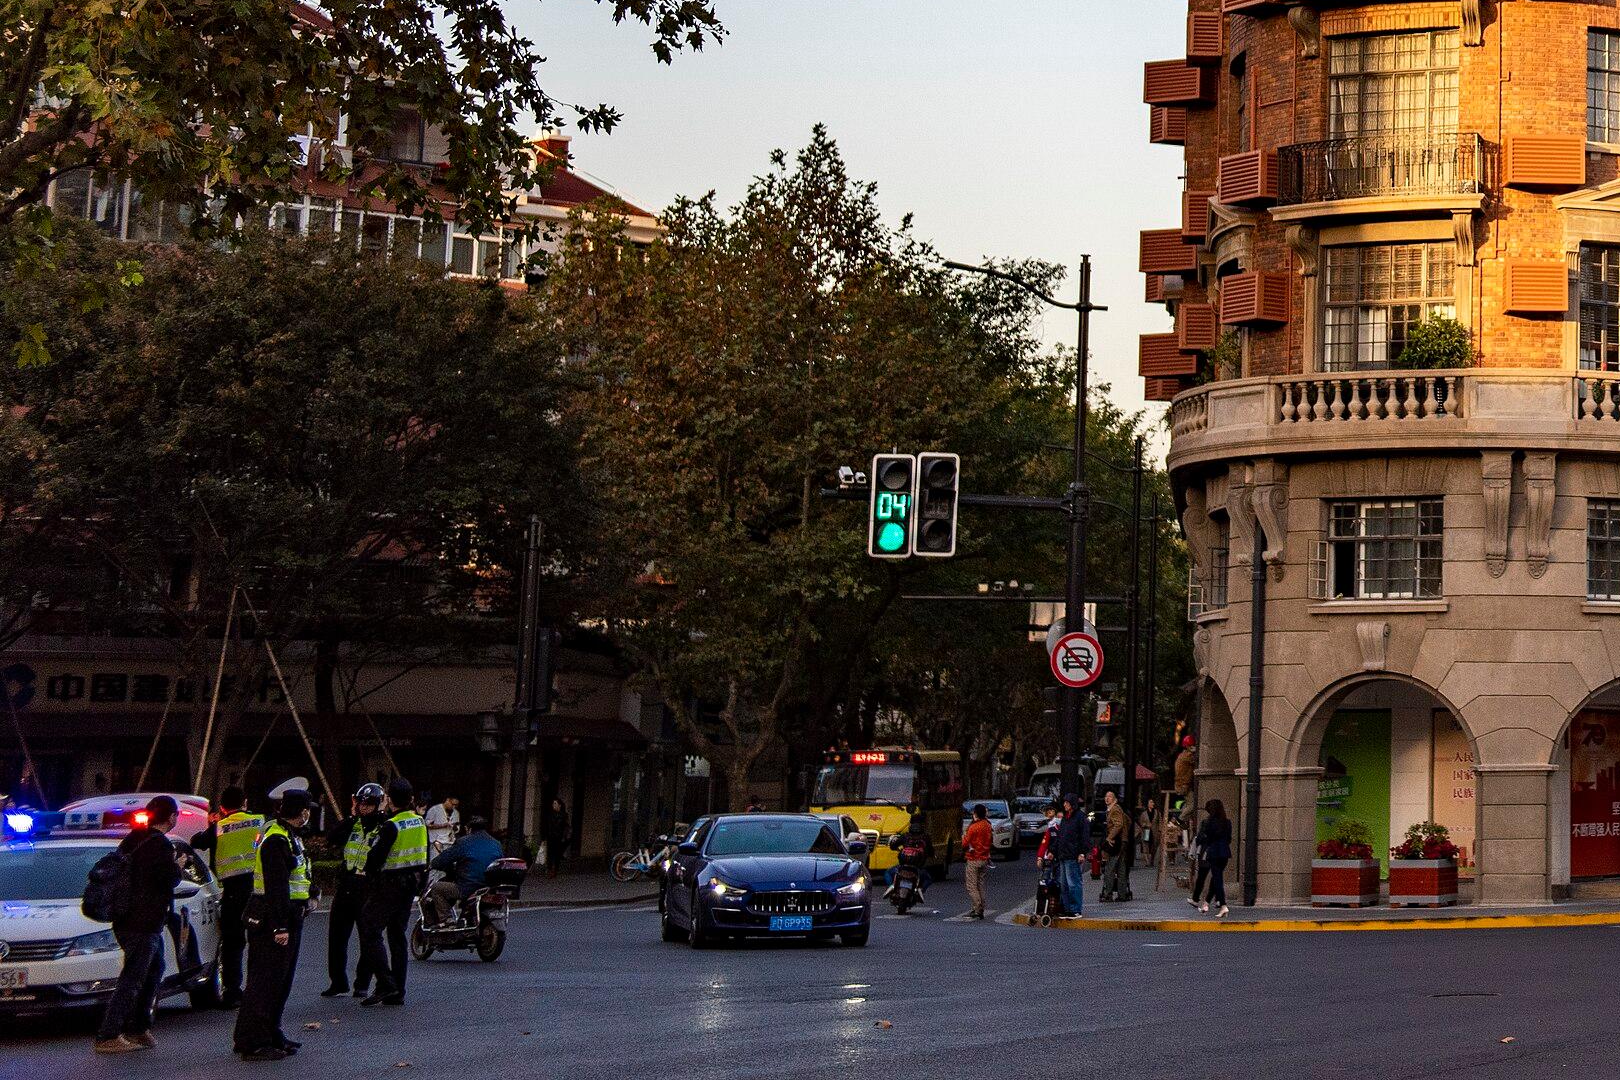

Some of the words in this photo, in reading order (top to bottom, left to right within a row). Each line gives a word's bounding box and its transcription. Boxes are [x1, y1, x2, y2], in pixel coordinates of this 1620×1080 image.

[878, 493, 907, 519] 04
[1453, 752, 1474, 763] 人民
[1453, 769, 1474, 781] 国家
[1453, 788, 1474, 799] 民族
